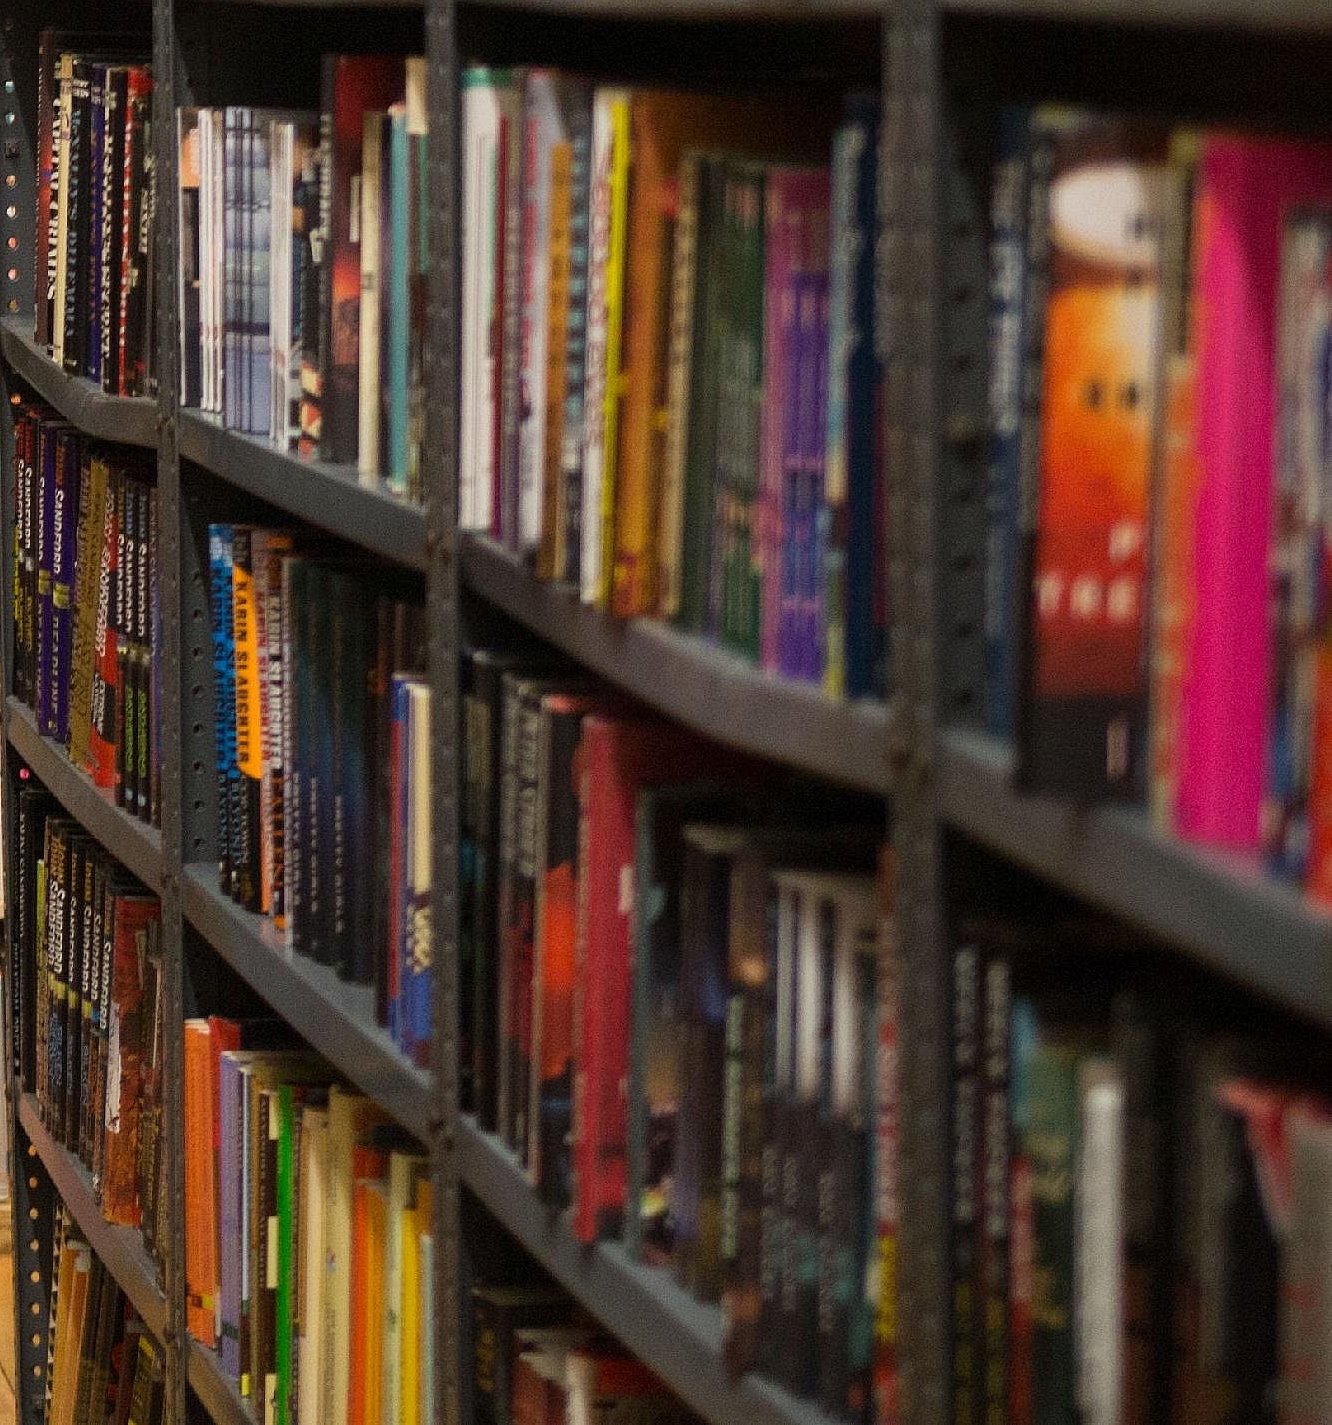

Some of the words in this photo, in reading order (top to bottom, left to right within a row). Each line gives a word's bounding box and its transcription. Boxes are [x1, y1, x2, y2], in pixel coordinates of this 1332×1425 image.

[52, 489, 64, 575] SANDFORD
[136, 542, 148, 637] SANDFORD
[234, 580, 249, 643] KARIN
[235, 649, 250, 765] SLAUGHTER
